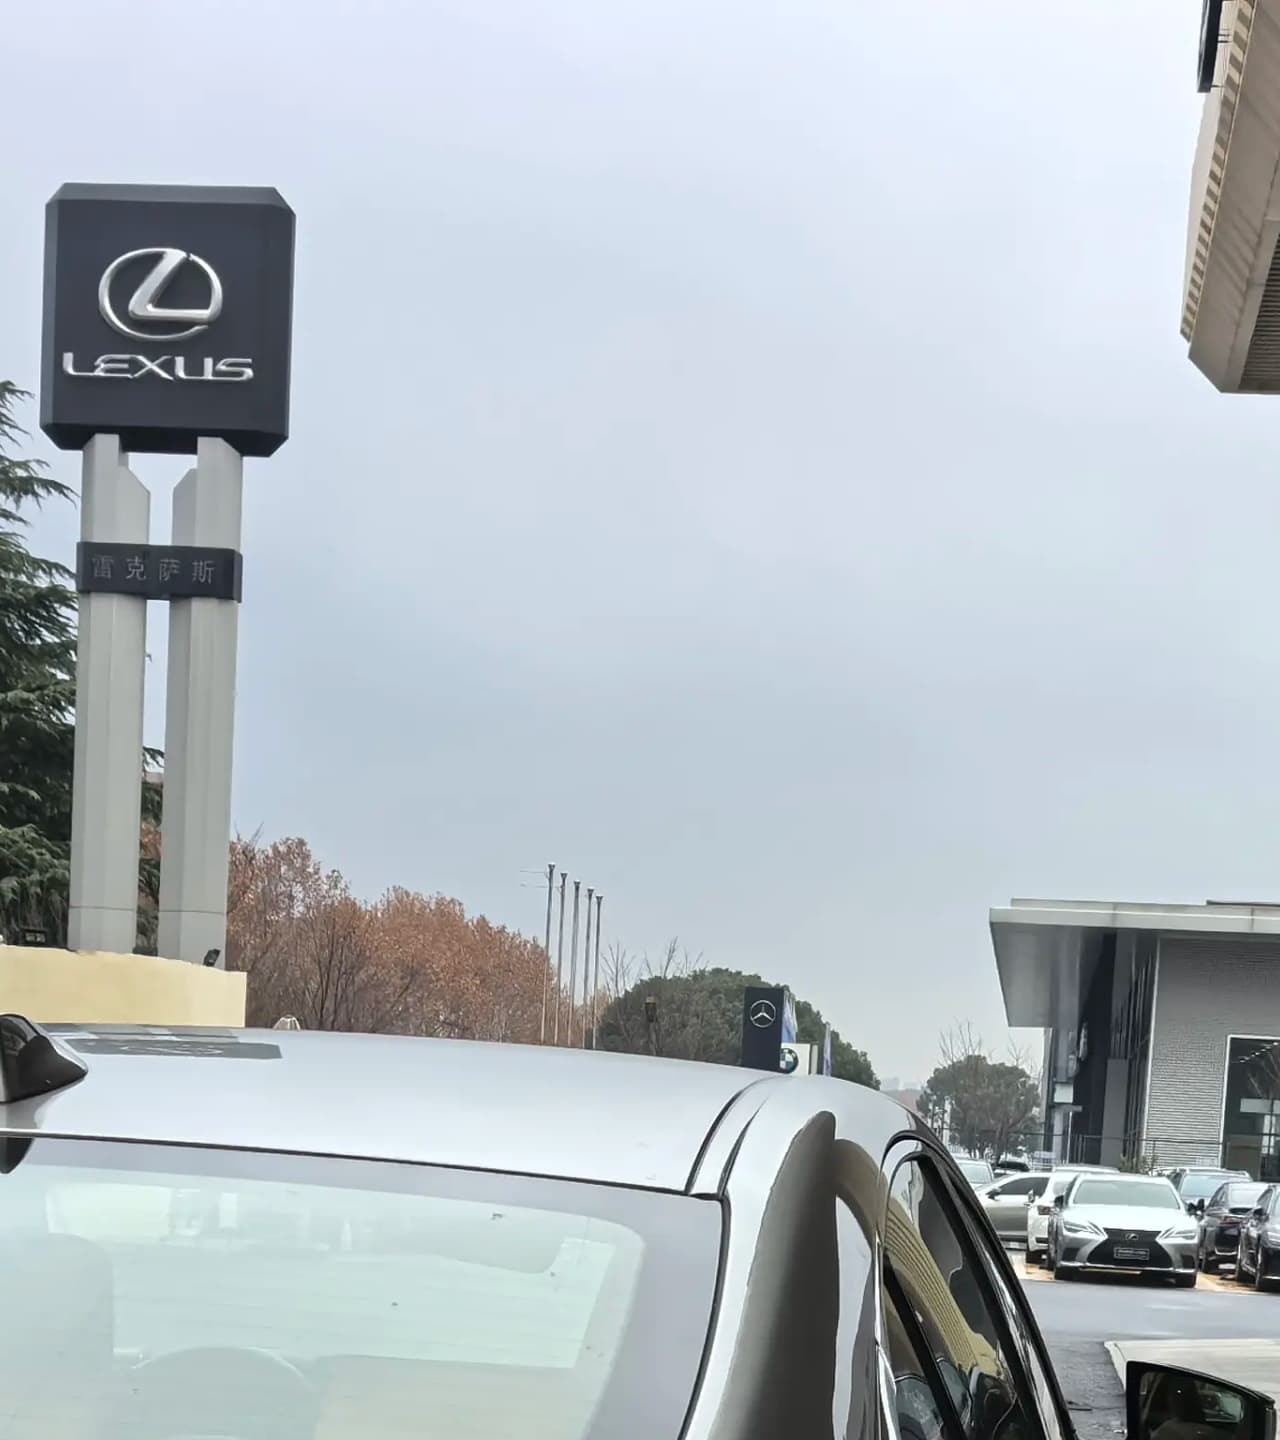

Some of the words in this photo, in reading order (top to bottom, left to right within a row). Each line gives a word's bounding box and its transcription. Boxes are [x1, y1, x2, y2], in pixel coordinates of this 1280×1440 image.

[63, 352, 254, 381] LEXUS
[92, 555, 215, 585] 雷克萨斯
